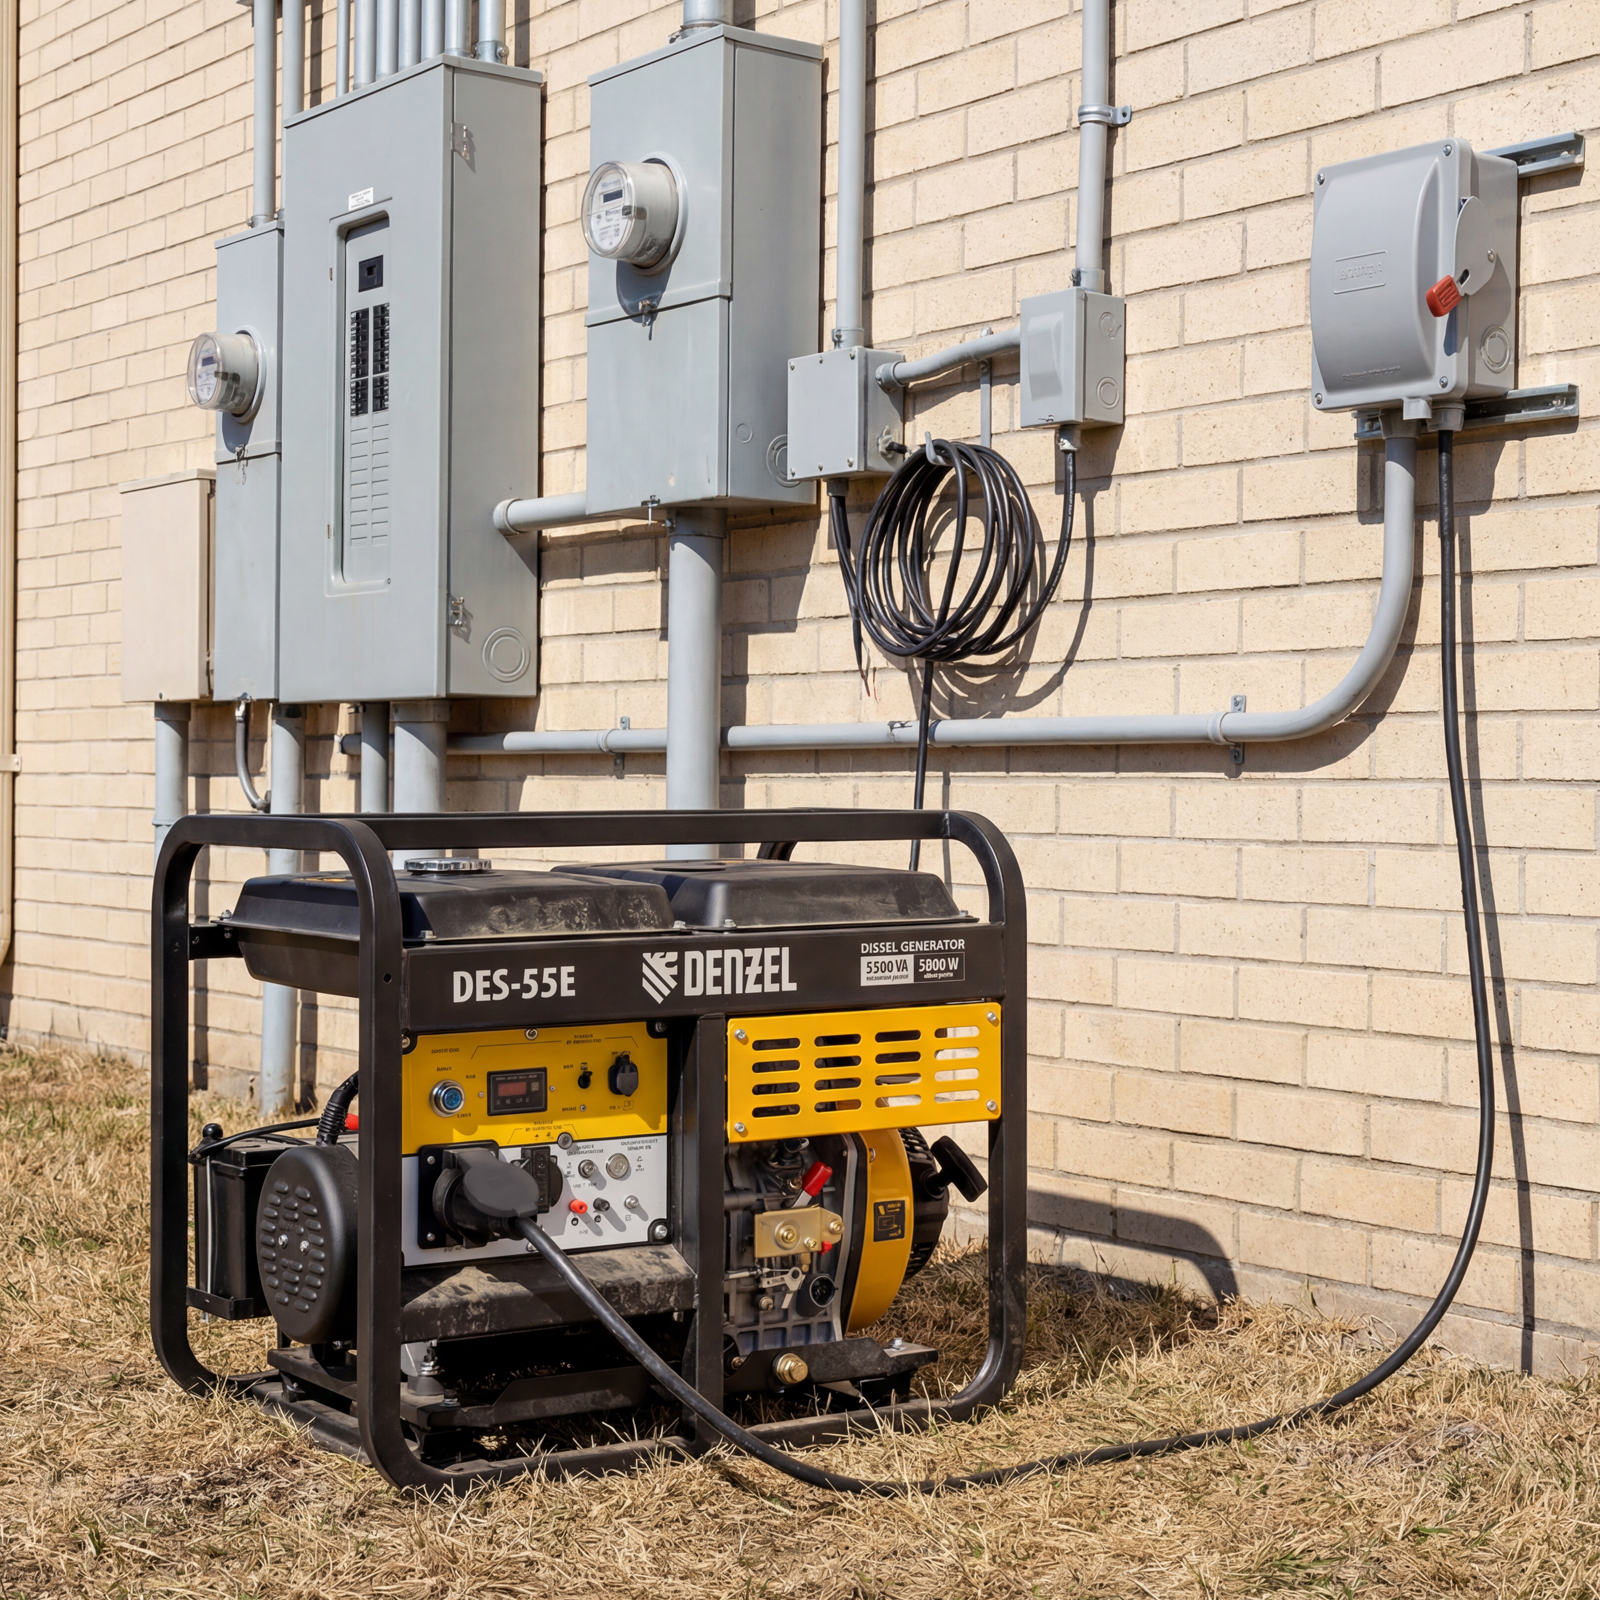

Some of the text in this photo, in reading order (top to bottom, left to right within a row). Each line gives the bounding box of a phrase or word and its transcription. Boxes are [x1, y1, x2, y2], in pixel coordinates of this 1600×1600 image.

[861, 939, 965, 954] DISSEL GENERATOR
[684, 947, 798, 997] DENZEL
[866, 959, 908, 974] 5500 VA
[918, 957, 959, 972] 5800 W
[453, 966, 576, 1003] DES-55E
